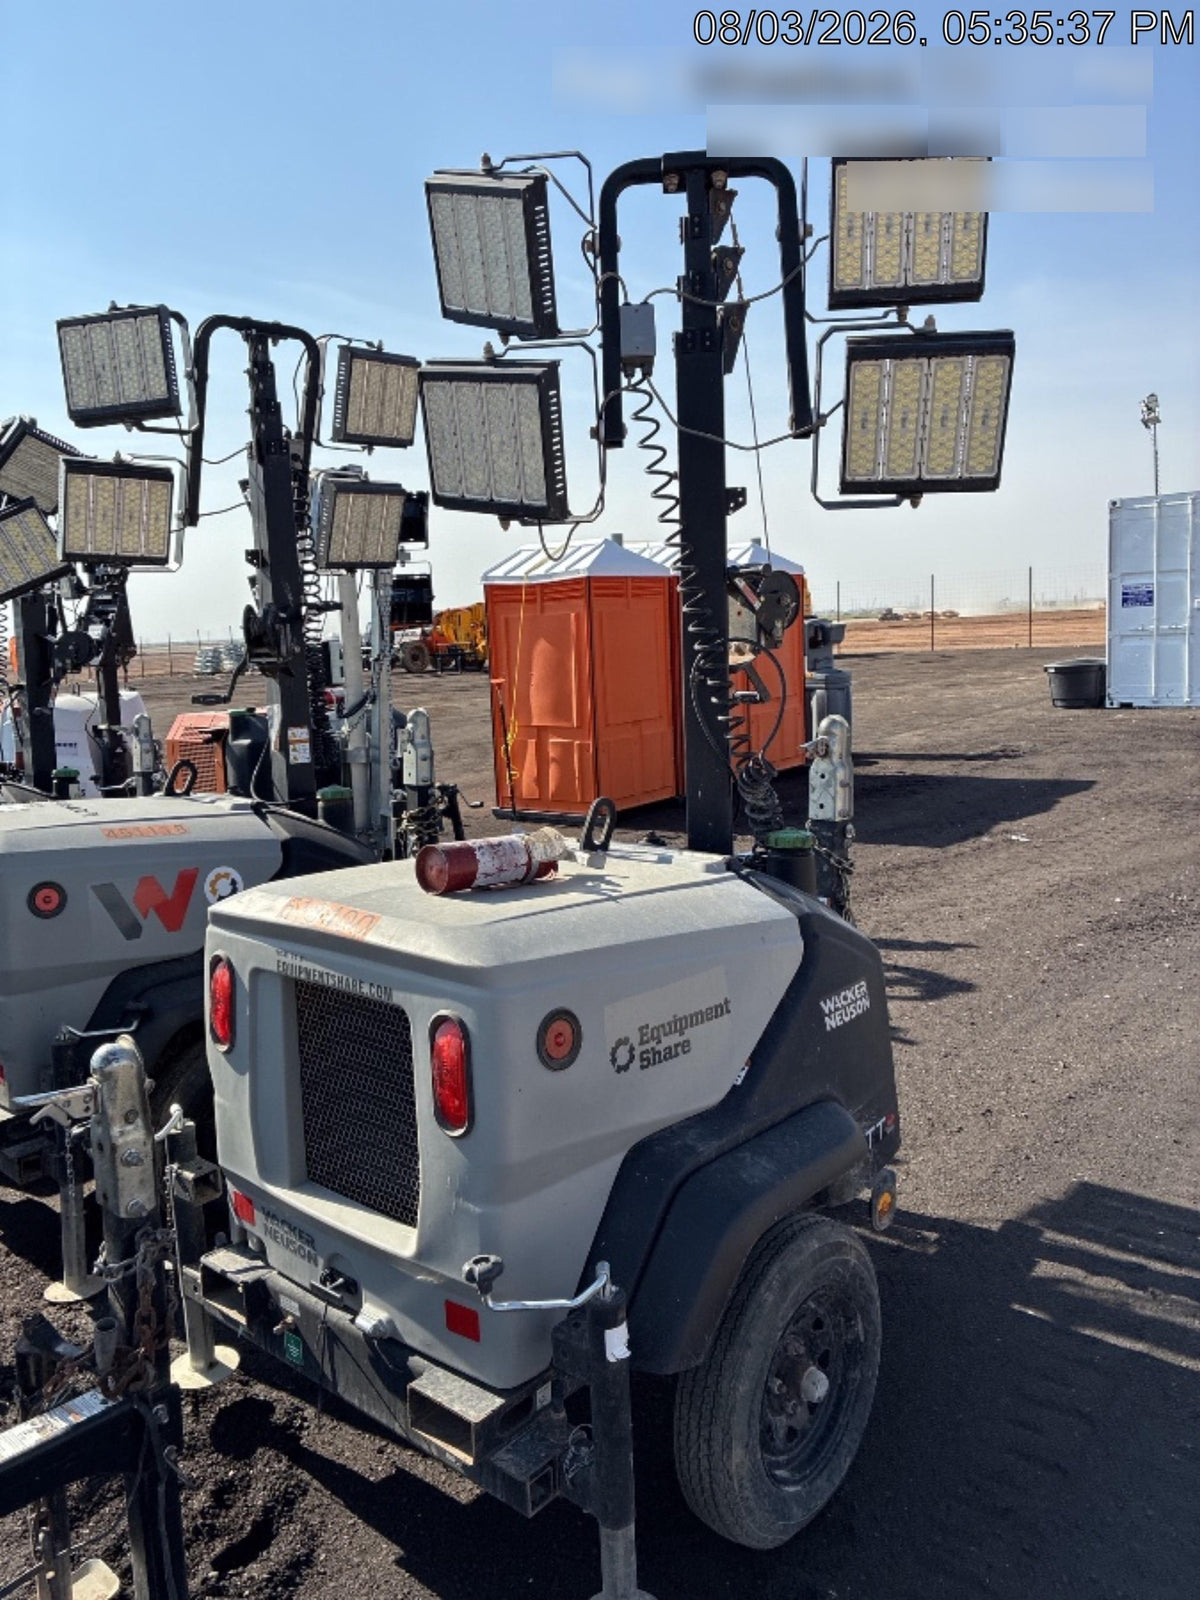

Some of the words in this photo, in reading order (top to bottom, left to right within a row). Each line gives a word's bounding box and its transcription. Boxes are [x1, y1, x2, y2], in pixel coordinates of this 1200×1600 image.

[276, 959, 394, 1002] EQUIPMENTSHARE.COM
[819, 980, 868, 1015] WACKER
[637, 997, 732, 1046] Equipment
[824, 996, 871, 1031] NEUSON
[639, 1037, 692, 1071] Share
[263, 1223, 319, 1268] NEUSON
